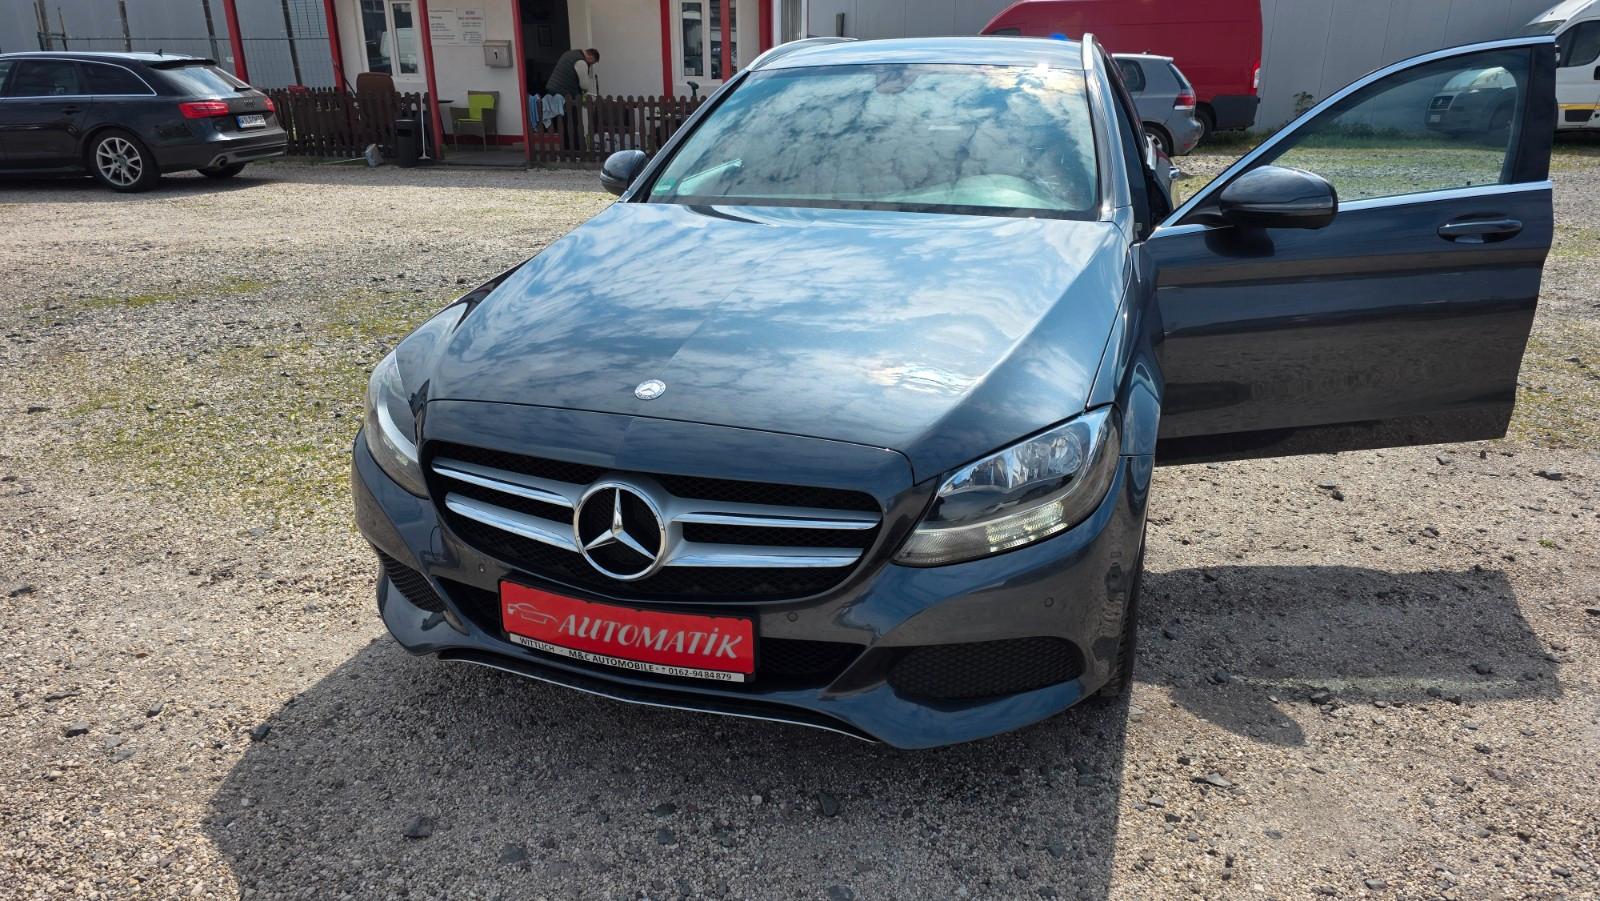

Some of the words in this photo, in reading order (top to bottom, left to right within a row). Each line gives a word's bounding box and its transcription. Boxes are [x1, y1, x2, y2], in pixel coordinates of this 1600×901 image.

[519, 637, 555, 652] WITTLICH
[568, 649, 591, 661] M&C
[592, 655, 654, 672] AUTOMOBILE
